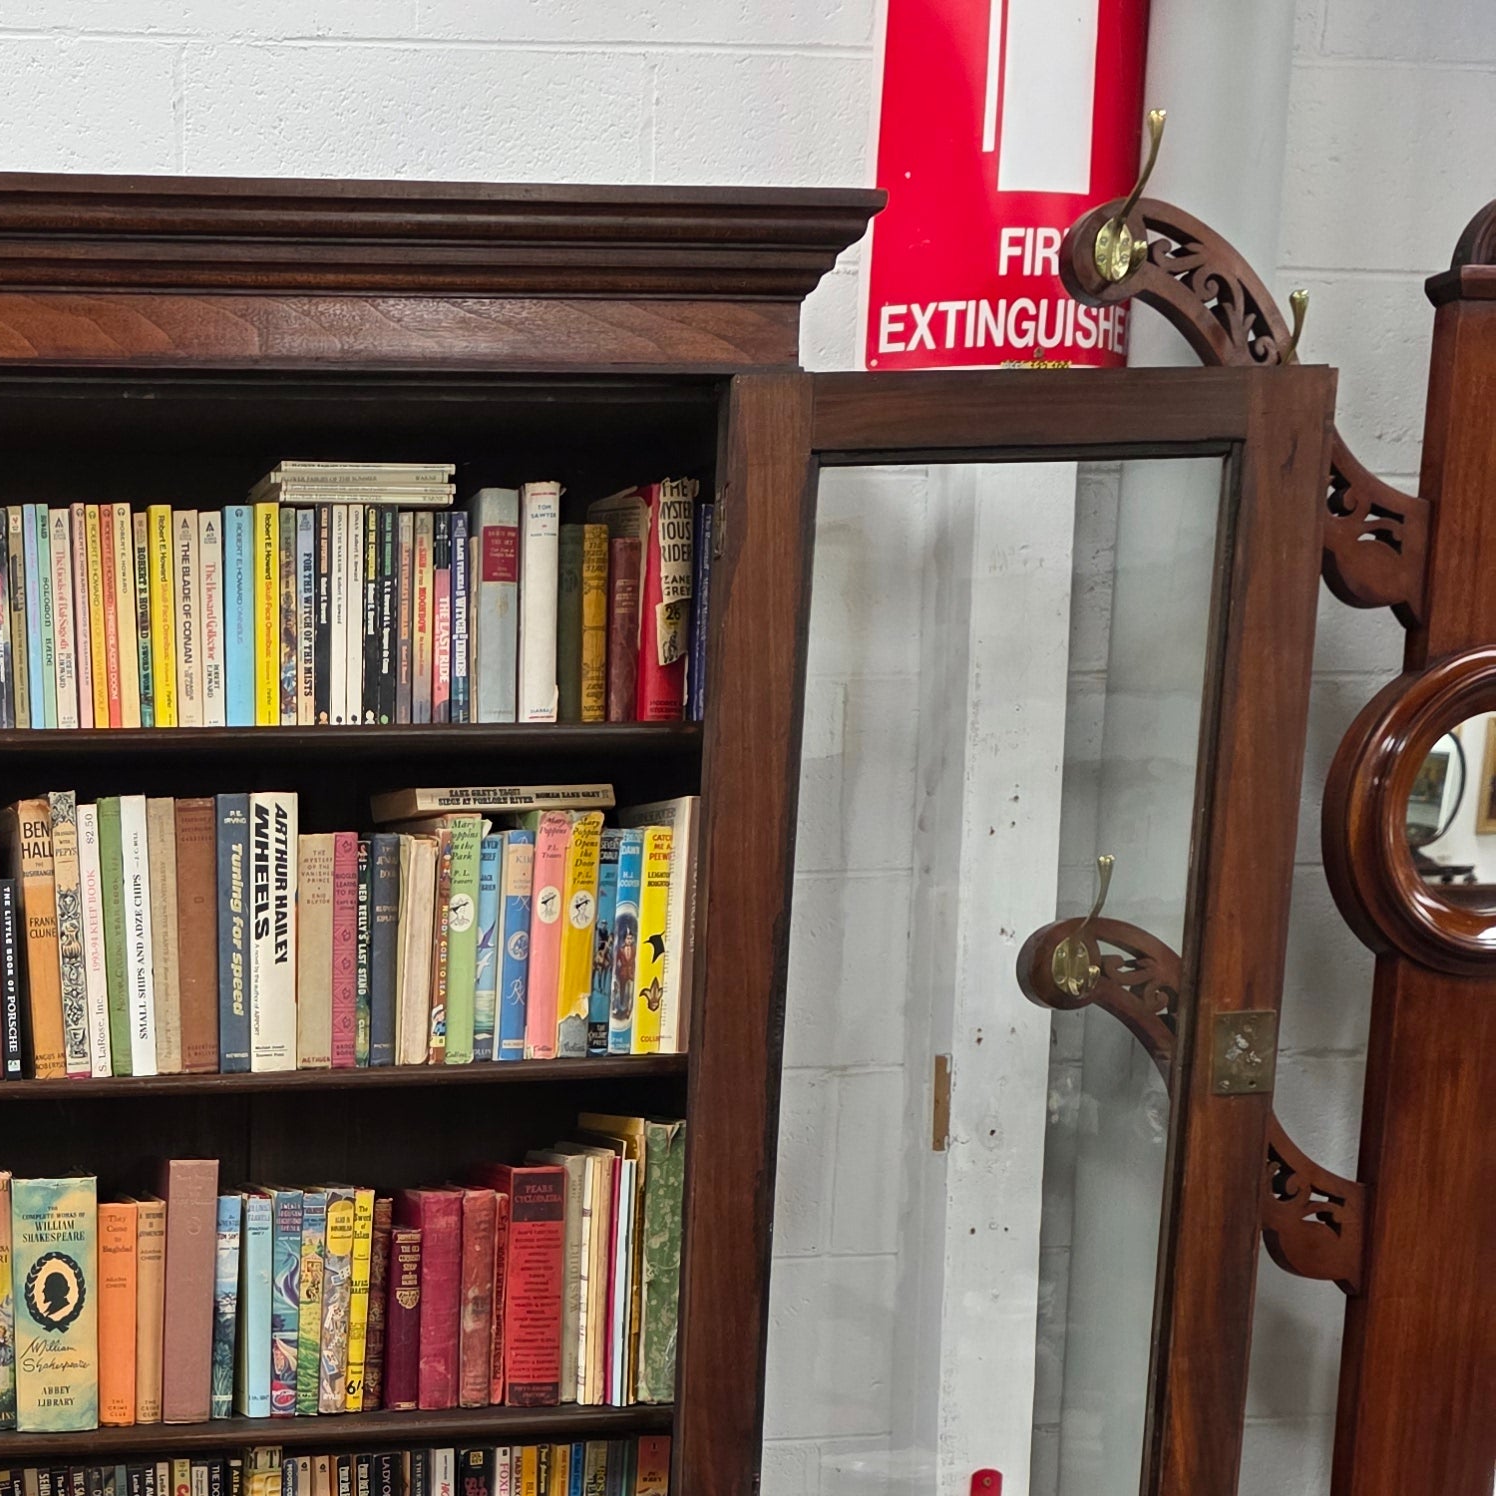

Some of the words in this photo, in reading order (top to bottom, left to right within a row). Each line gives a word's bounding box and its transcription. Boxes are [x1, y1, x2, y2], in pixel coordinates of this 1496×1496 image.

[998, 227, 1065, 276] FIR
[878, 298, 1130, 354] EXTINGUISHE
[181, 543, 191, 564] THE
[303, 553, 313, 572] FOR
[182, 566, 192, 602] BLADE
[304, 573, 312, 594] THE
[182, 604, 192, 618] OF
[304, 596, 312, 628] WITCH
[439, 596, 449, 620] THE
[183, 621, 193, 664] CONAN
[304, 631, 312, 643] OF
[439, 622, 450, 653] LAST
[304, 645, 312, 664] THE
[304, 666, 313, 697] MISTS
[439, 655, 450, 683] RIDE
[23, 821, 50, 839] BEN
[275, 802, 288, 894] ARTHUR
[230, 843, 244, 913] Tuning
[254, 802, 270, 941] WHEELS
[3, 887, 11, 906] THE
[132, 874, 142, 907] CHIPS
[358, 884, 367, 902] NED
[4, 910, 13, 944] LITTLE
[135, 910, 144, 939] ADZE
[232, 917, 244, 949] for
[275, 895, 288, 965] HAILEY
[358, 905, 367, 941] KELLY'S
[5, 948, 14, 976] BOOK
[136, 943, 145, 964] AND
[358, 944, 367, 964] LAST
[6, 980, 15, 993] OF
[137, 968, 147, 999] SHIPS
[231, 952, 245, 1016] speed
[358, 968, 367, 996] STAND
[7, 995, 18, 1052] PORSCHE
[138, 1004, 148, 1040] SMALL
[524, 1184, 553, 1194] PEARS
[22, 1212, 55, 1220] COMPLETE
[56, 1211, 78, 1219] WORKS
[34, 1220, 75, 1232] WILLIAM
[22, 1231, 86, 1243] SHAKESPEARE
[37, 1397, 76, 1407] LIBRARY
[41, 1386, 71, 1395] ABBEY
[212, 1465, 220, 1482] THE
[381, 1456, 391, 1483] LADY
